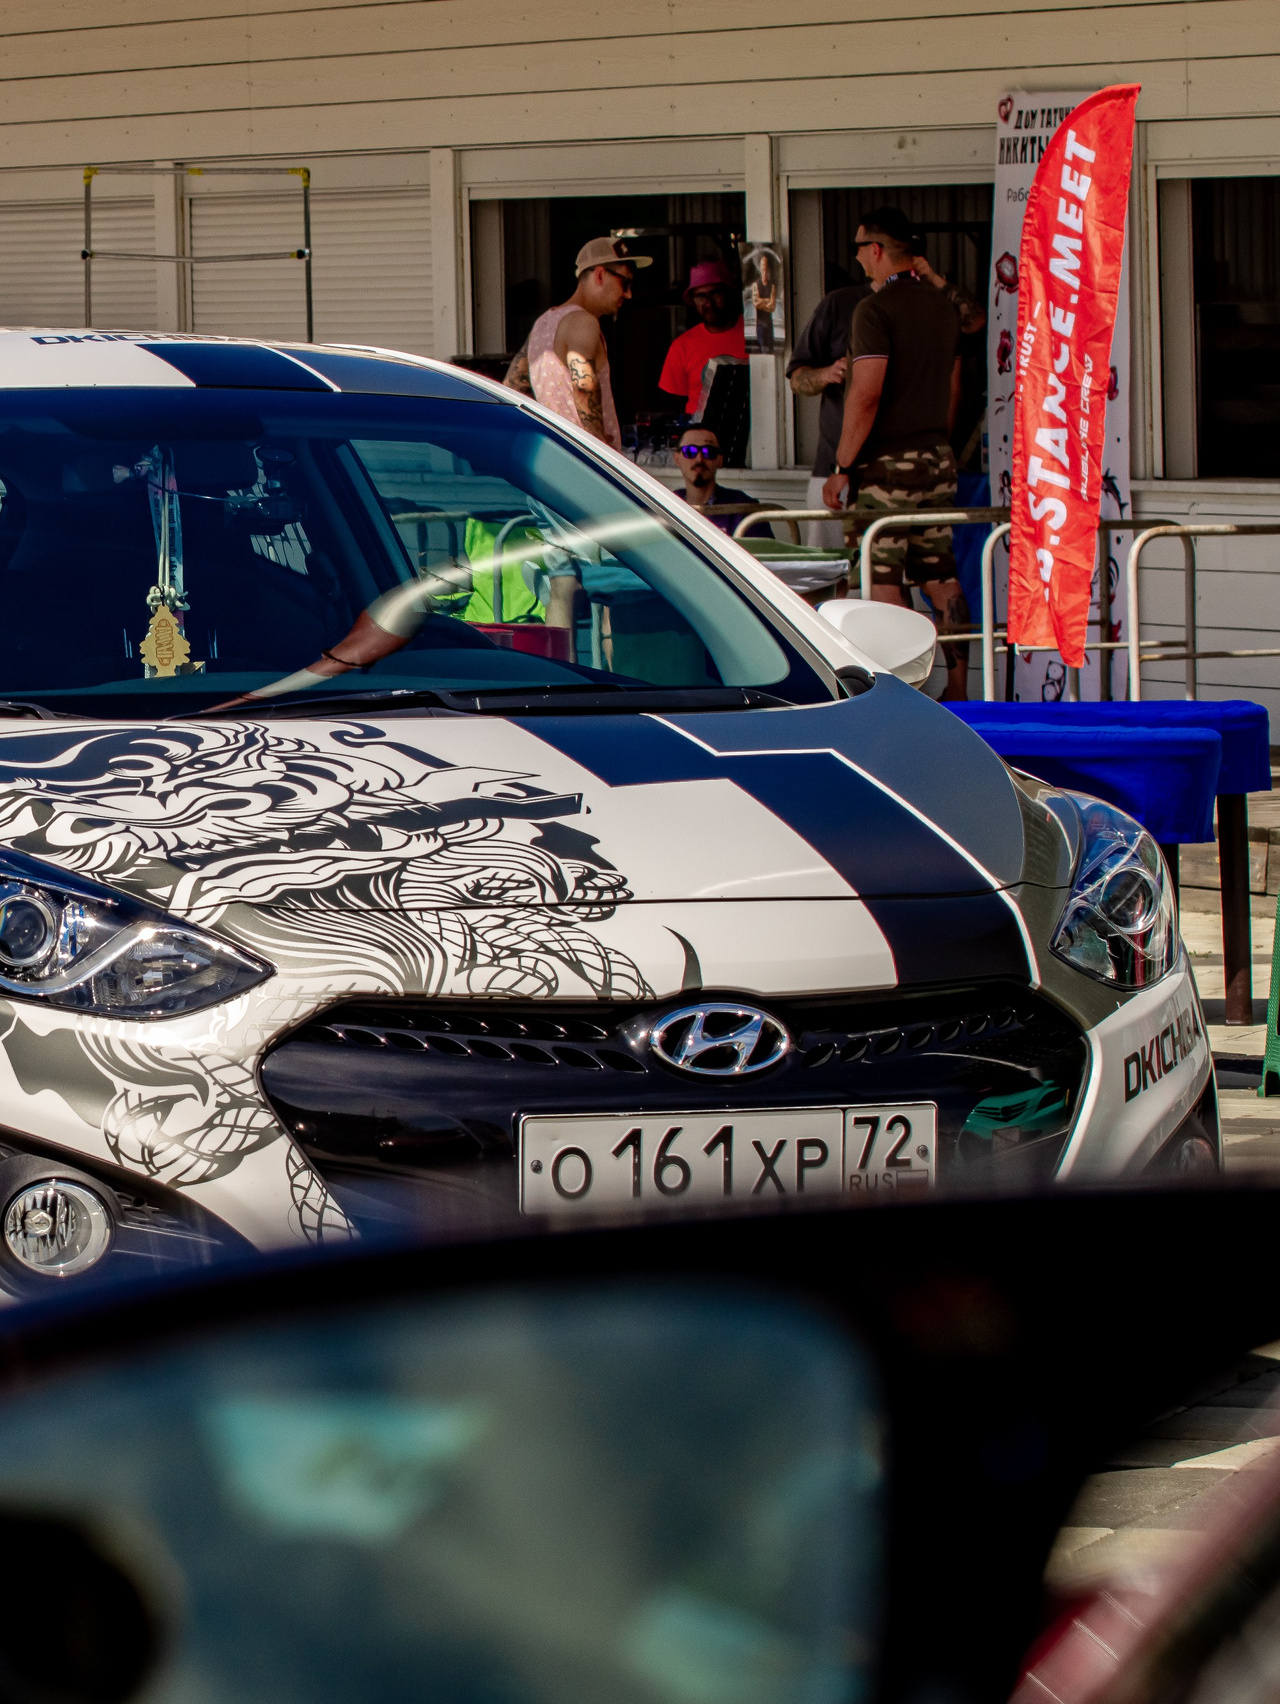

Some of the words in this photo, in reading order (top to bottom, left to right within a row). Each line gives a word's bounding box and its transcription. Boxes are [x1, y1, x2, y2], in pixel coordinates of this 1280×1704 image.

[1014, 109, 1037, 129] ДОМ
[1080, 353, 1094, 415] CREW
[852, 1114, 913, 1171] 72
